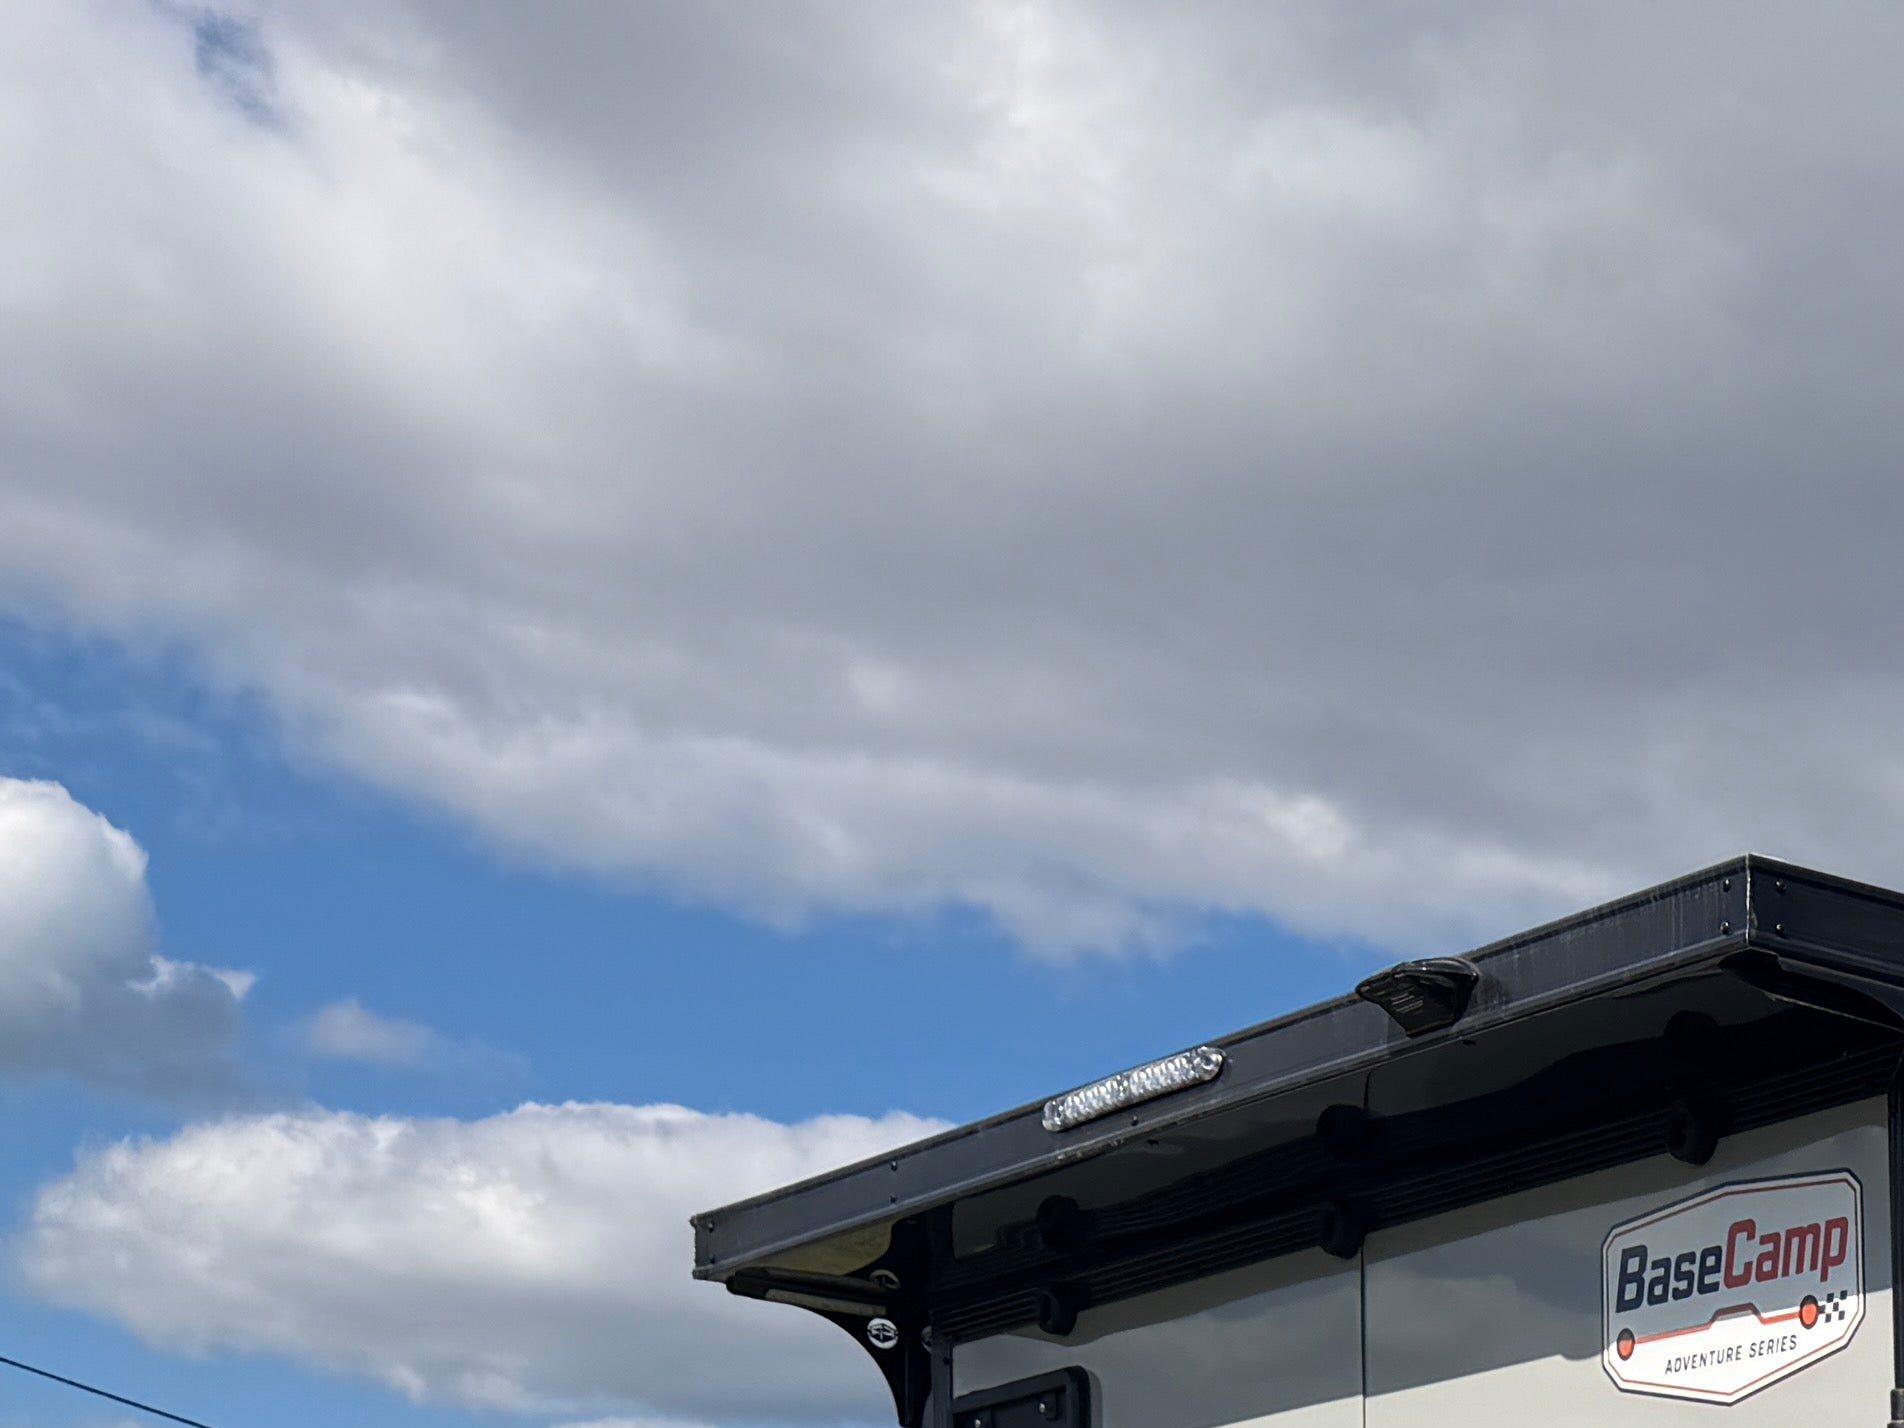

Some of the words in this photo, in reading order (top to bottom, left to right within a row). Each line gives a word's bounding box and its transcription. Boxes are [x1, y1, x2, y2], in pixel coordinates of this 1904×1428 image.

[1616, 1217, 1849, 1313] BaseCamp
[1664, 1345, 1742, 1375] ADVENTURE
[1749, 1334, 1797, 1358] SERIES
